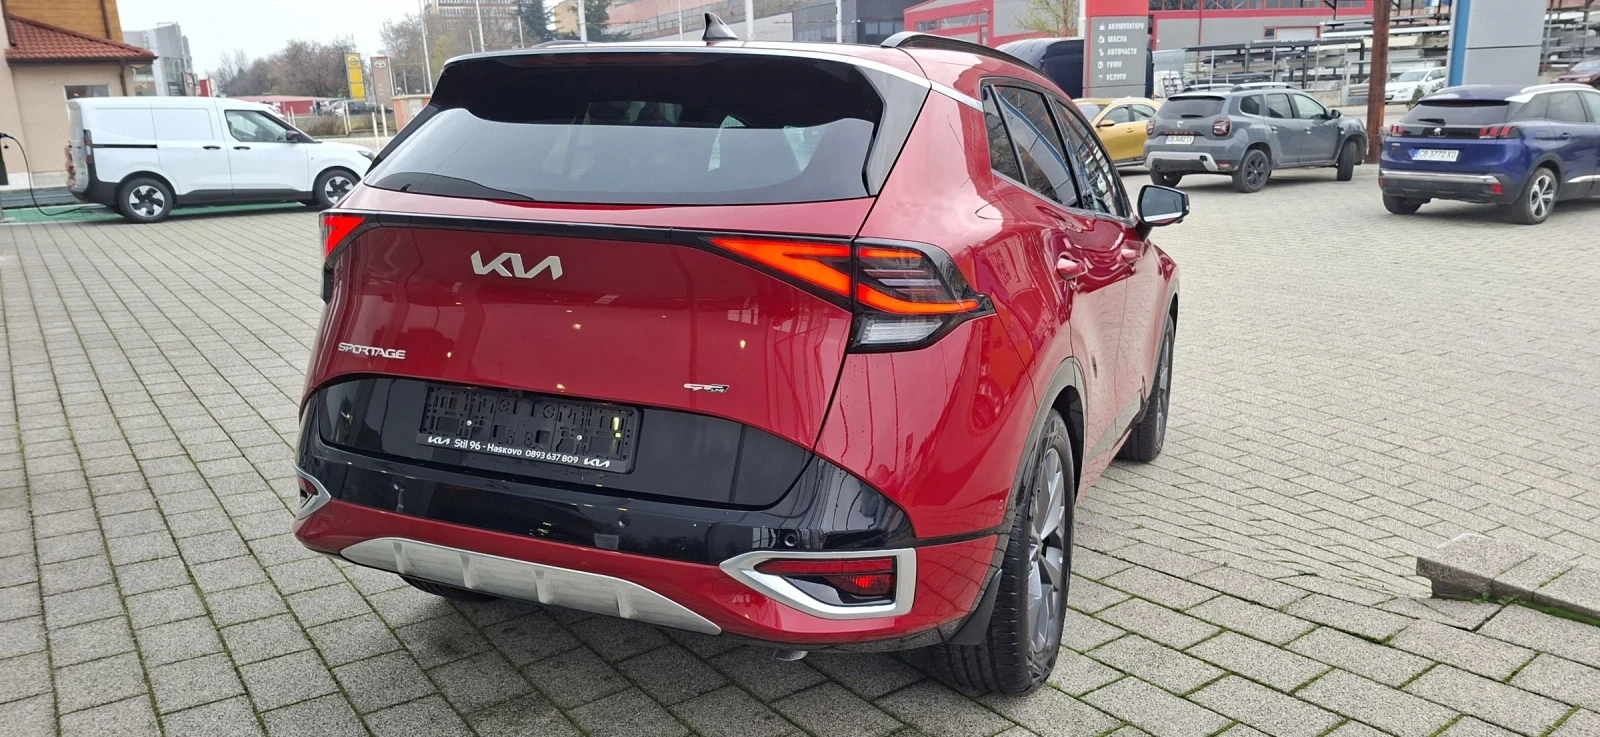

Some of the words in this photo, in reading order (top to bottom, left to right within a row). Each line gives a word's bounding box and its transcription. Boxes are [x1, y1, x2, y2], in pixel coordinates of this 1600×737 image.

[1107, 22, 1145, 30] АКУМУЛАТОРИ
[1107, 35, 1127, 43] МАСЛА
[1106, 73, 1127, 81] УСЛУГИ
[470, 250, 563, 281] KIA
[338, 342, 406, 360] SPORTAGE
[428, 436, 450, 445] KIA
[454, 438, 468, 448] Stil
[470, 440, 481, 450] 96
[486, 443, 522, 456] Haskovo
[525, 450, 546, 459] 0893
[546, 452, 561, 461] 637
[562, 454, 578, 464] 809
[584, 458, 610, 468] KIA
